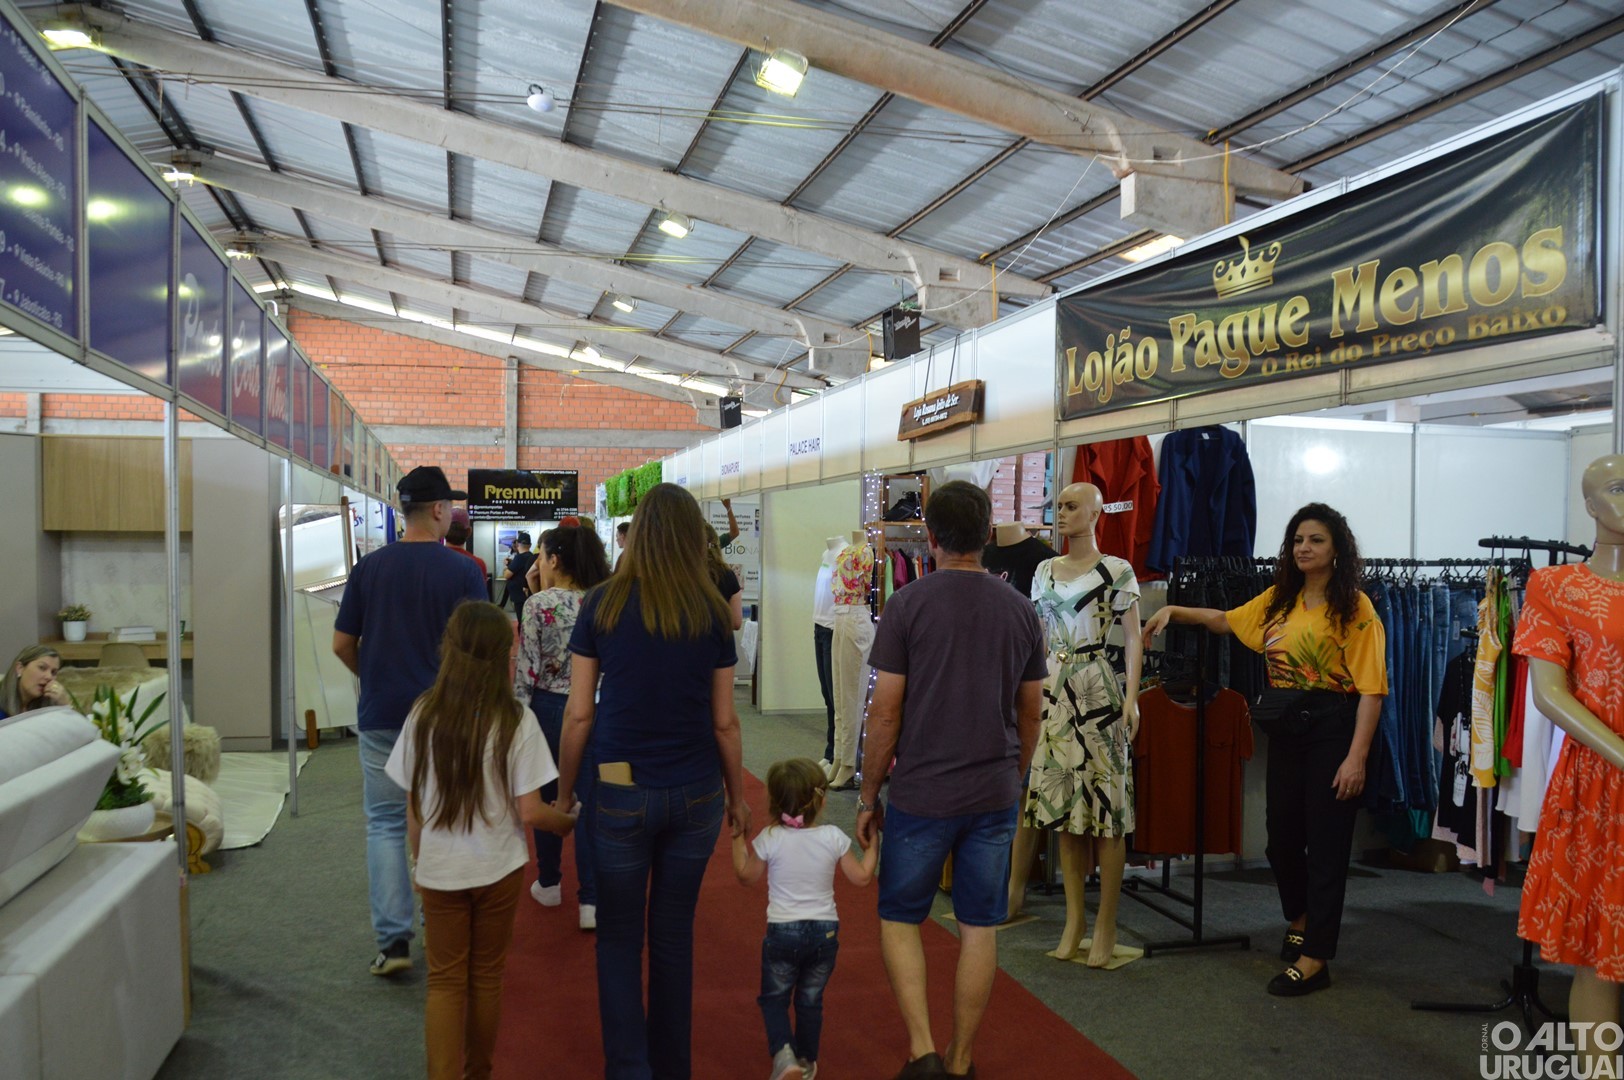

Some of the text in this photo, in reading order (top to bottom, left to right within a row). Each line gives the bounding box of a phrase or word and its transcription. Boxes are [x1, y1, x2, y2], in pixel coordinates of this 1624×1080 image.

[1066, 226, 1568, 403] Lojão Pague Menos
[1286, 342, 1323, 373] Rei
[1330, 340, 1364, 363] do
[1372, 324, 1456, 358] Preço
[1468, 304, 1567, 340] Baixo
[789, 437, 821, 456] PALACE HAIR
[484, 485, 562, 500] Premium
